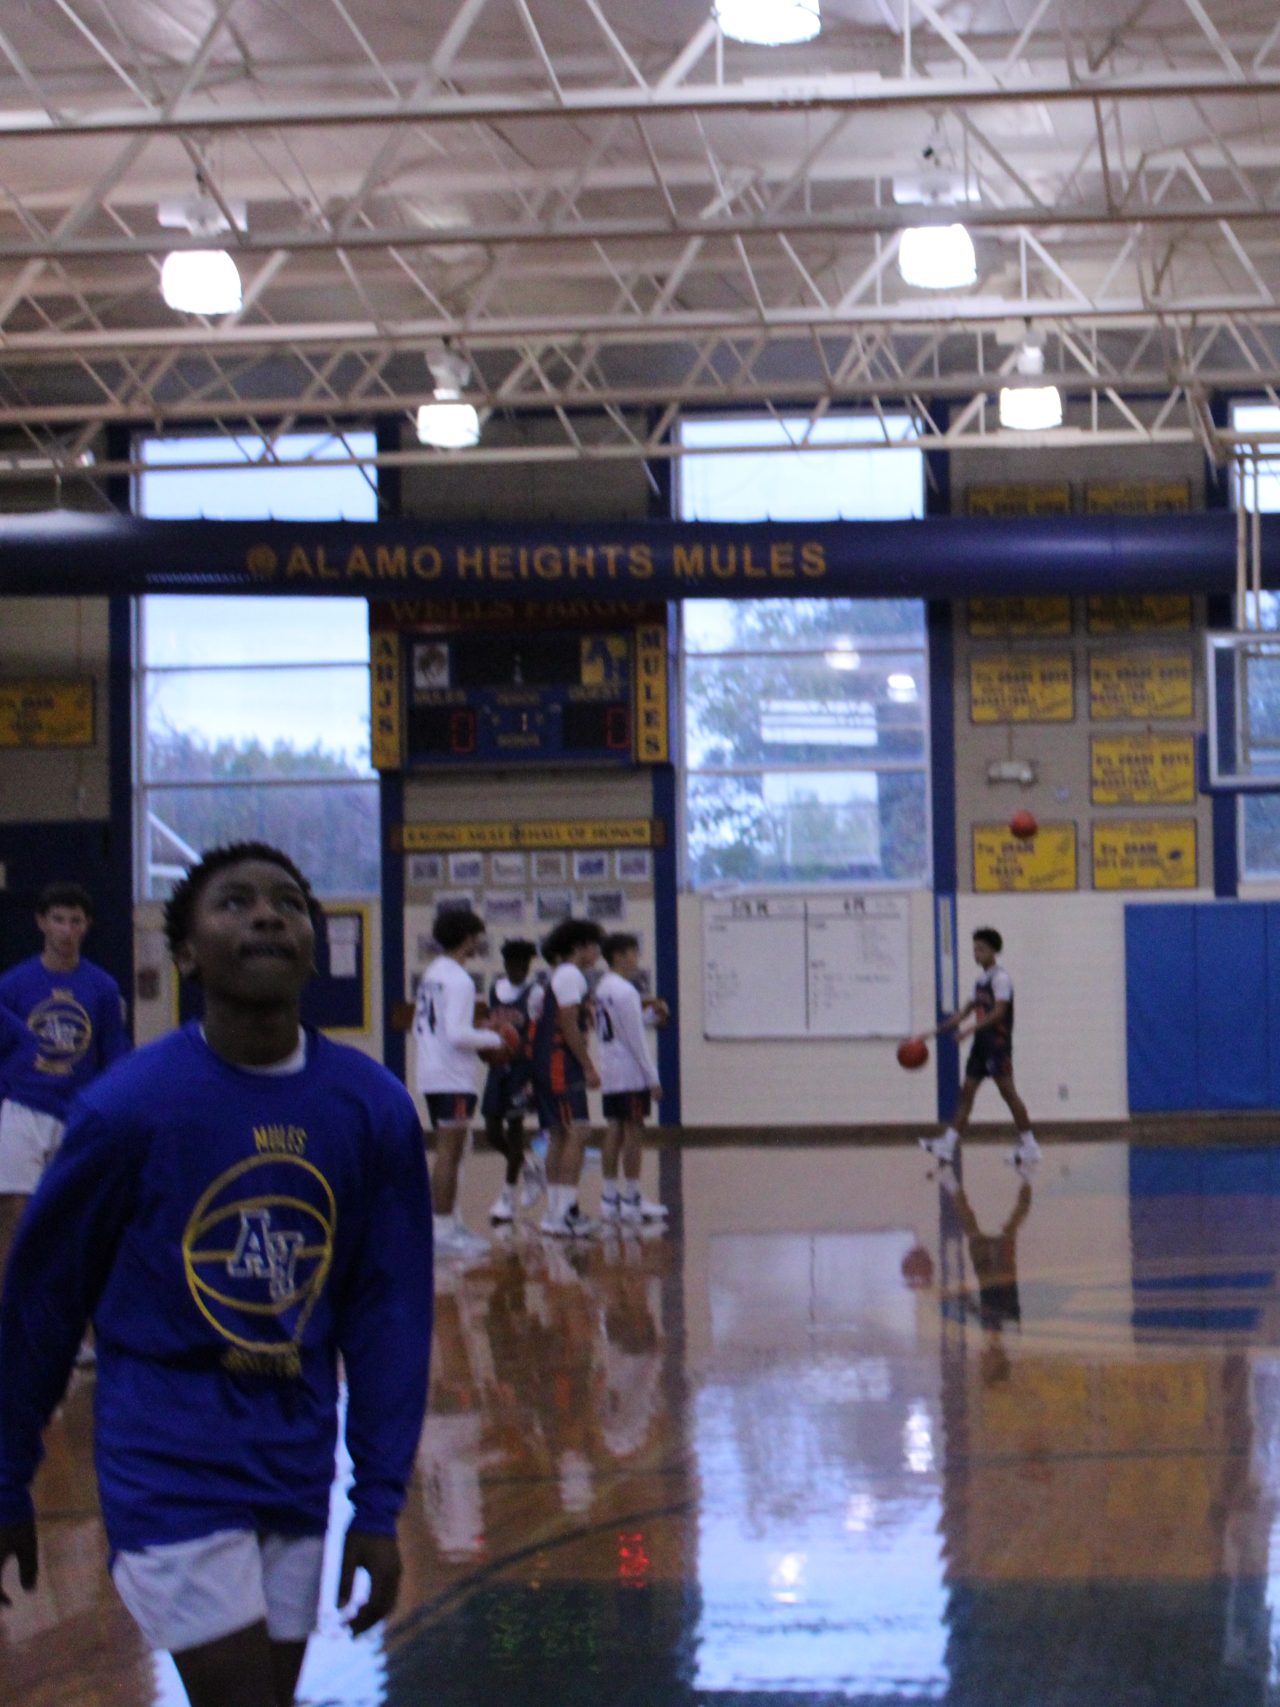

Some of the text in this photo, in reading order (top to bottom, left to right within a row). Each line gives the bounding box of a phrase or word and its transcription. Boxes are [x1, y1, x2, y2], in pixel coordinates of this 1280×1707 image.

[286, 543, 826, 580] ALAMO HEIGHTS MULES
[641, 631, 661, 753] MULES
